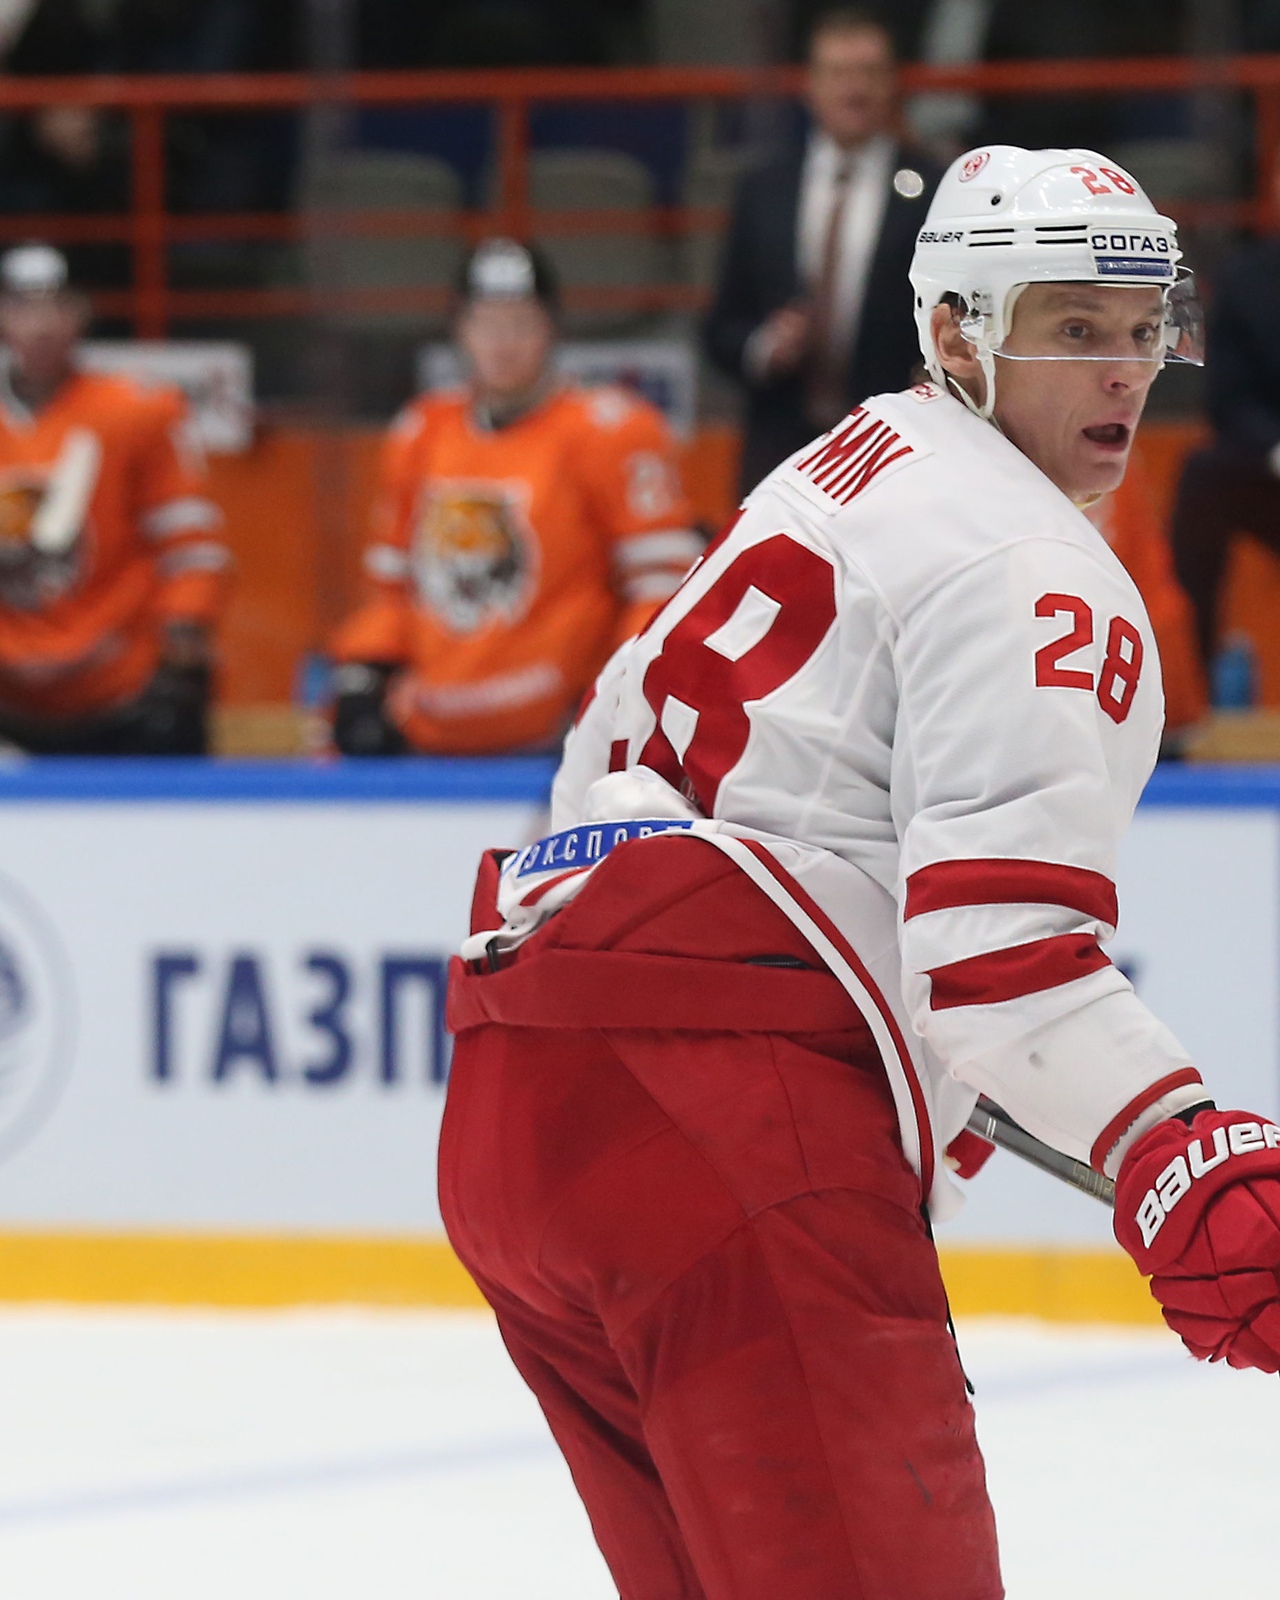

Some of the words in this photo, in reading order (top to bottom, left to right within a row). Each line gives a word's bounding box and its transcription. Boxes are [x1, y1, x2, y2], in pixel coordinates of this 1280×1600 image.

[1070, 166, 1137, 196] 28
[1091, 235, 1169, 252] СОГАЗ
[609, 509, 838, 818] 8
[1033, 592, 1144, 725] 28
